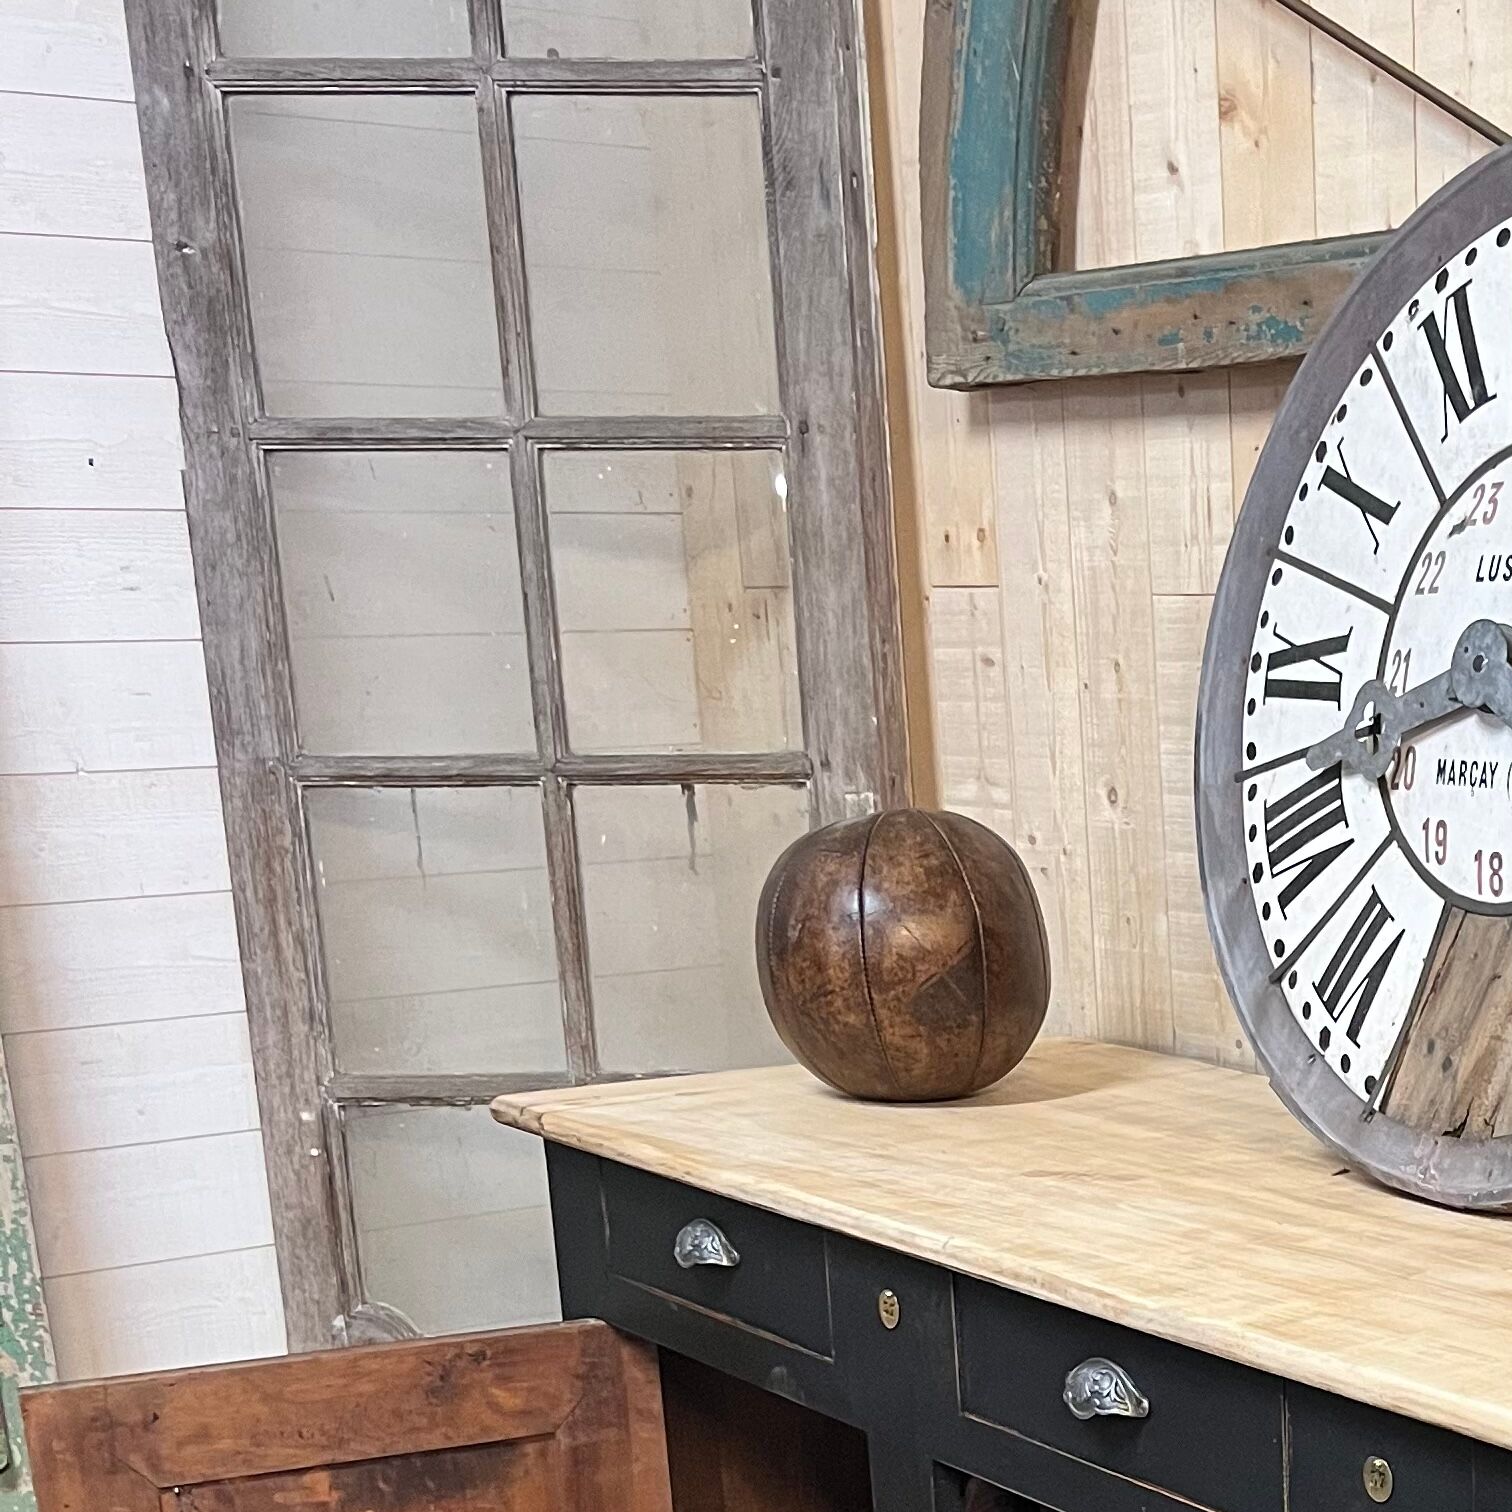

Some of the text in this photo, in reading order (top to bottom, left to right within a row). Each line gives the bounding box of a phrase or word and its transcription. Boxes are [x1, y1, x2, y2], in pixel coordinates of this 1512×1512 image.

[1416, 278, 1498, 443] XI
[1317, 437, 1401, 555] X
[1465, 481, 1504, 526] 23
[1415, 550, 1446, 596] 22
[1262, 622, 1353, 711] IX
[1390, 648, 1411, 693] 21
[1391, 745, 1416, 791] 20
[1435, 758, 1499, 797] MARÇAY
[1264, 760, 1354, 920] VIII
[1421, 816, 1448, 866] 19
[1474, 849, 1503, 897] 18
[1311, 884, 1406, 1049] VII
